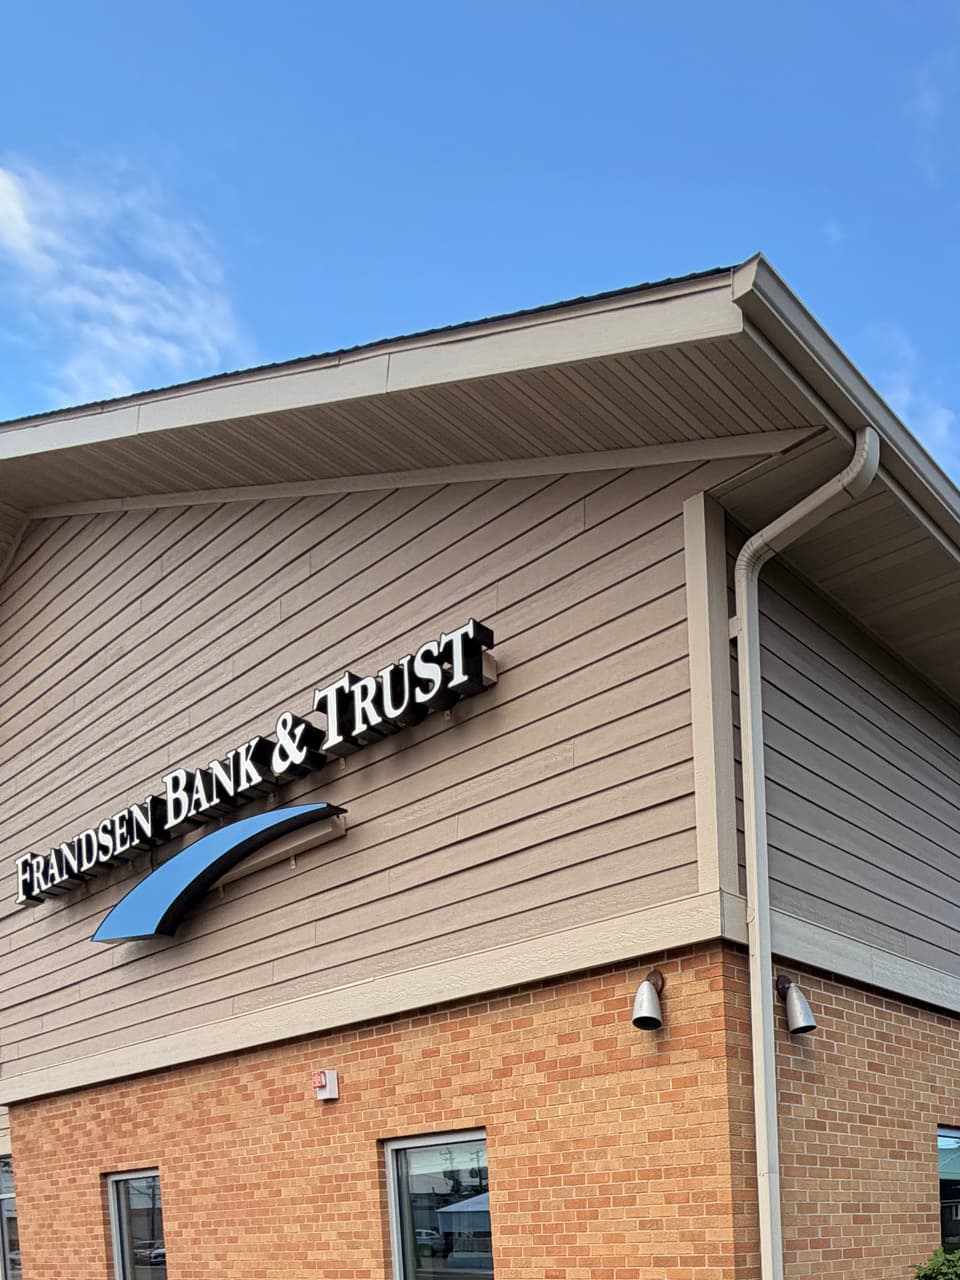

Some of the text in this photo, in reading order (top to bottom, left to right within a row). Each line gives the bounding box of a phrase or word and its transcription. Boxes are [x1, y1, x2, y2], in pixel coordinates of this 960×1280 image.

[15, 617, 479, 904] FRANDSEN BANK & TRUST
